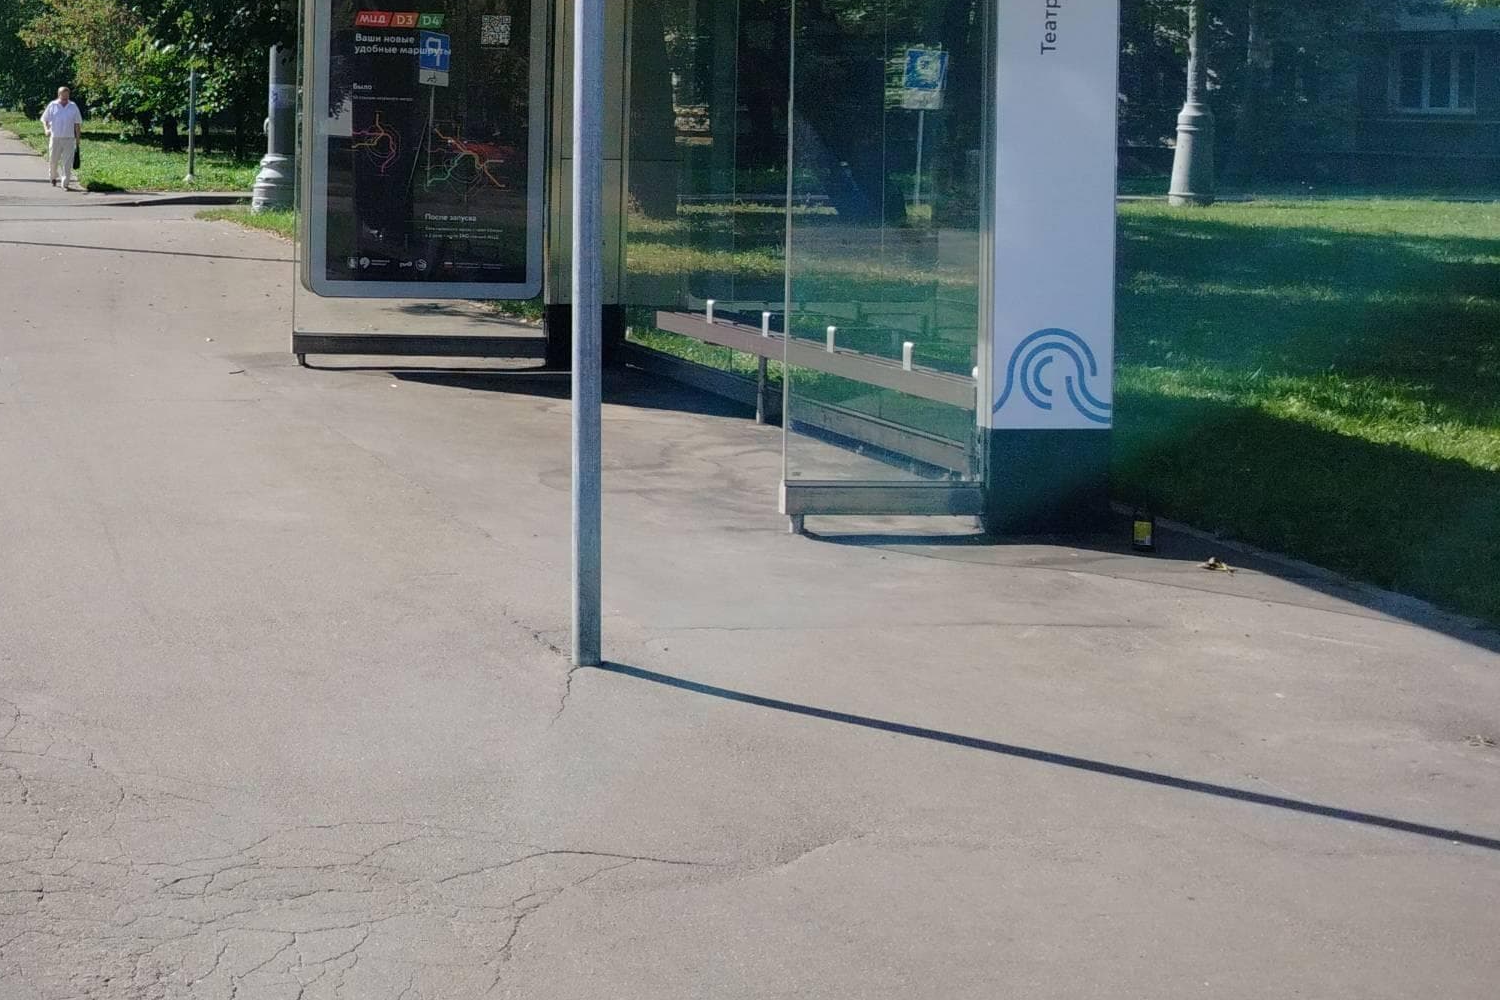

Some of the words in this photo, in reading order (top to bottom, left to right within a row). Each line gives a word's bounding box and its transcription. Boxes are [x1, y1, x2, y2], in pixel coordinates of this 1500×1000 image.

[396, 15, 413, 25] D3
[423, 16, 440, 26] D4
[355, 33, 380, 42] Ваши
[354, 45, 397, 54] удобные
[425, 213, 448, 221] После
